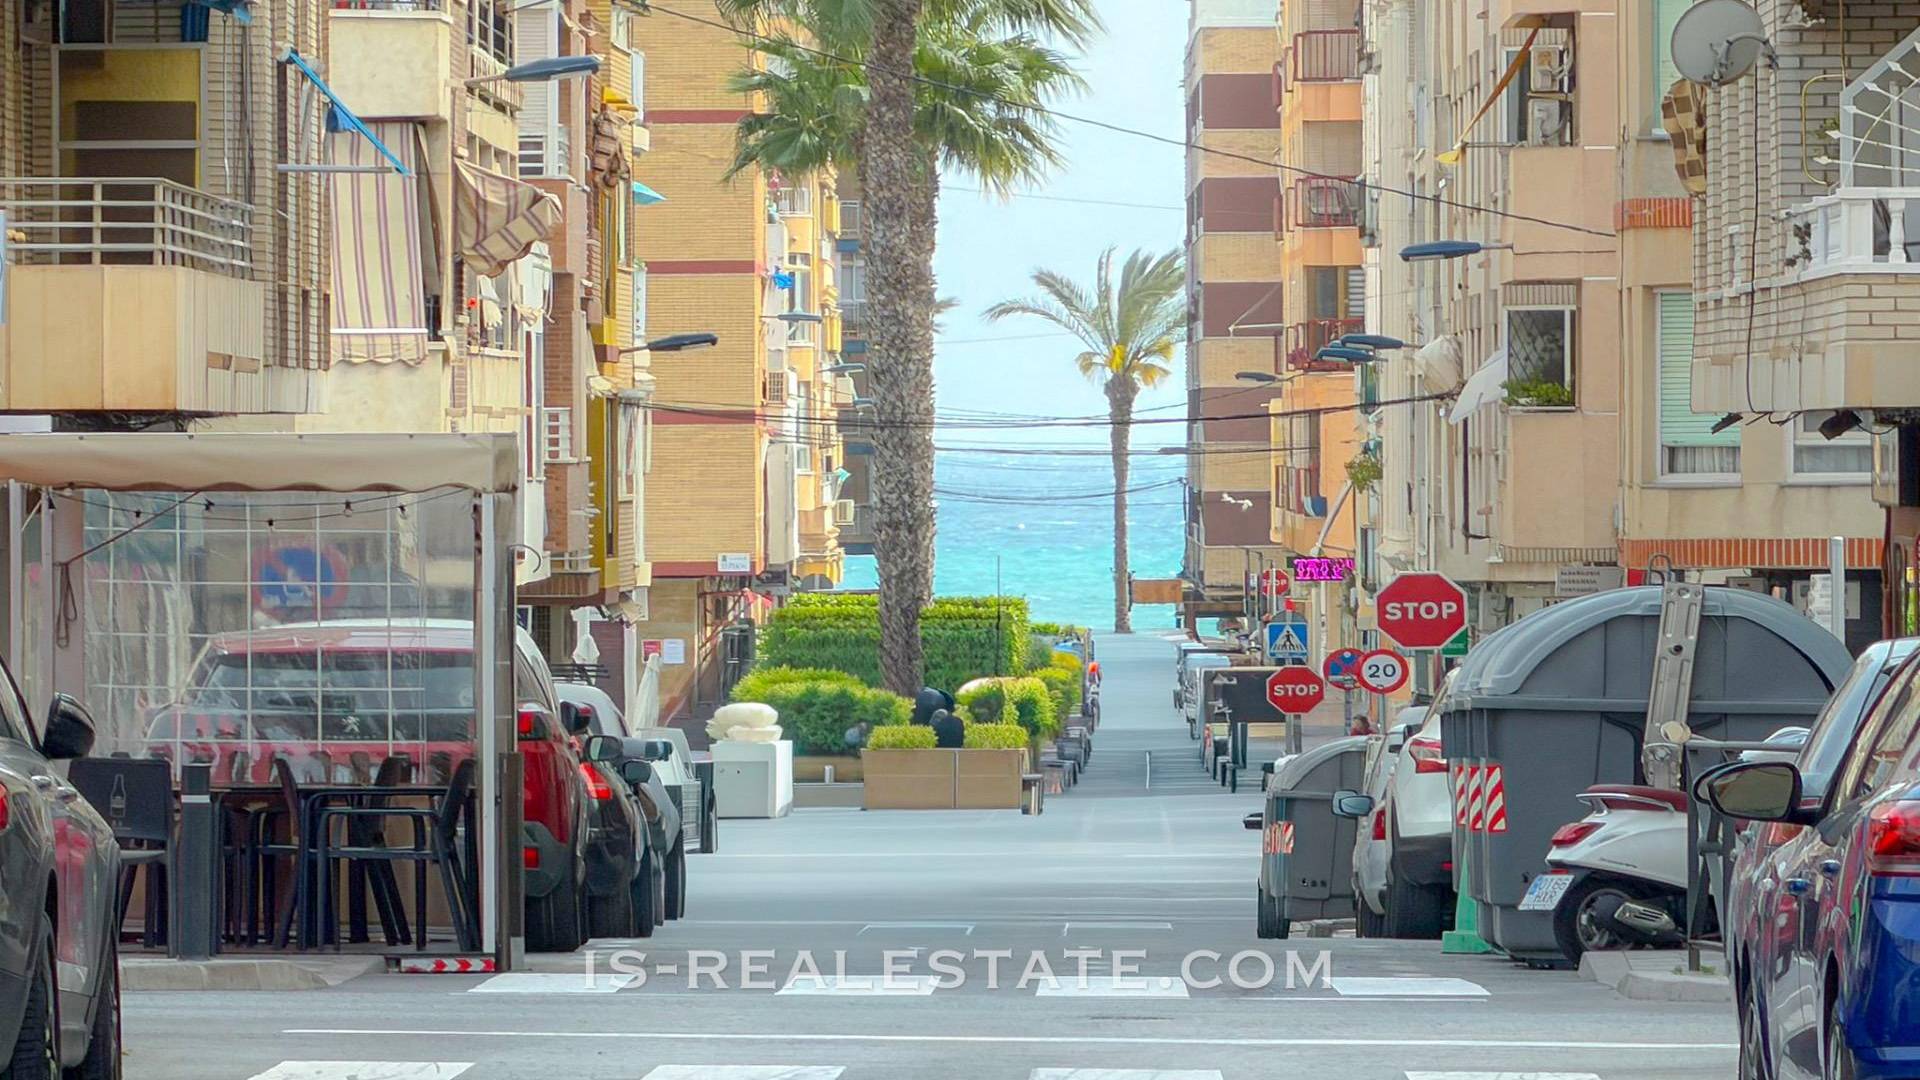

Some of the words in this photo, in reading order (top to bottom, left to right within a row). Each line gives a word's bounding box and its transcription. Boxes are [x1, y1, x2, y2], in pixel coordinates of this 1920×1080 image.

[1384, 601, 1458, 620] STOP
[1368, 663, 1397, 679] 20
[1273, 684, 1320, 697] STOP
